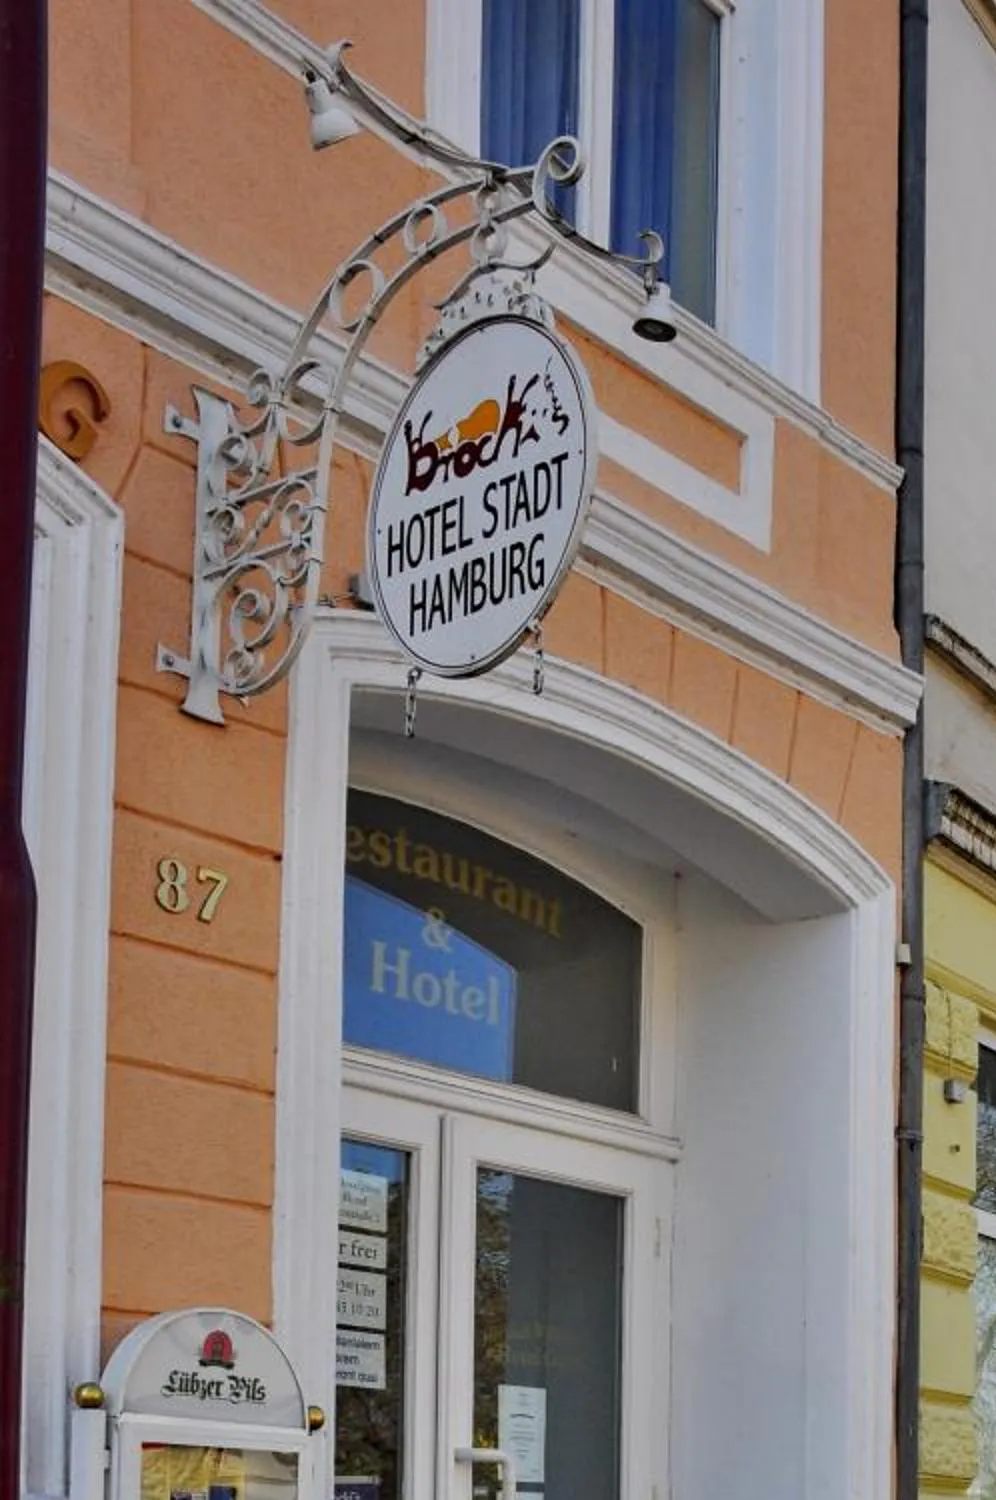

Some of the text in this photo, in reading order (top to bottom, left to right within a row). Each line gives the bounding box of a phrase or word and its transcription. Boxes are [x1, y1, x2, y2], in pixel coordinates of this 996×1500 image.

[386, 452, 569, 578] HOTEL STADT
[408, 532, 546, 637] HAMBURG
[154, 857, 228, 925] 87
[345, 825, 563, 939] estaurant
[421, 906, 453, 951] &
[368, 939, 500, 1026] Hotel
[160, 1369, 268, 1405] Lübzer Pils
